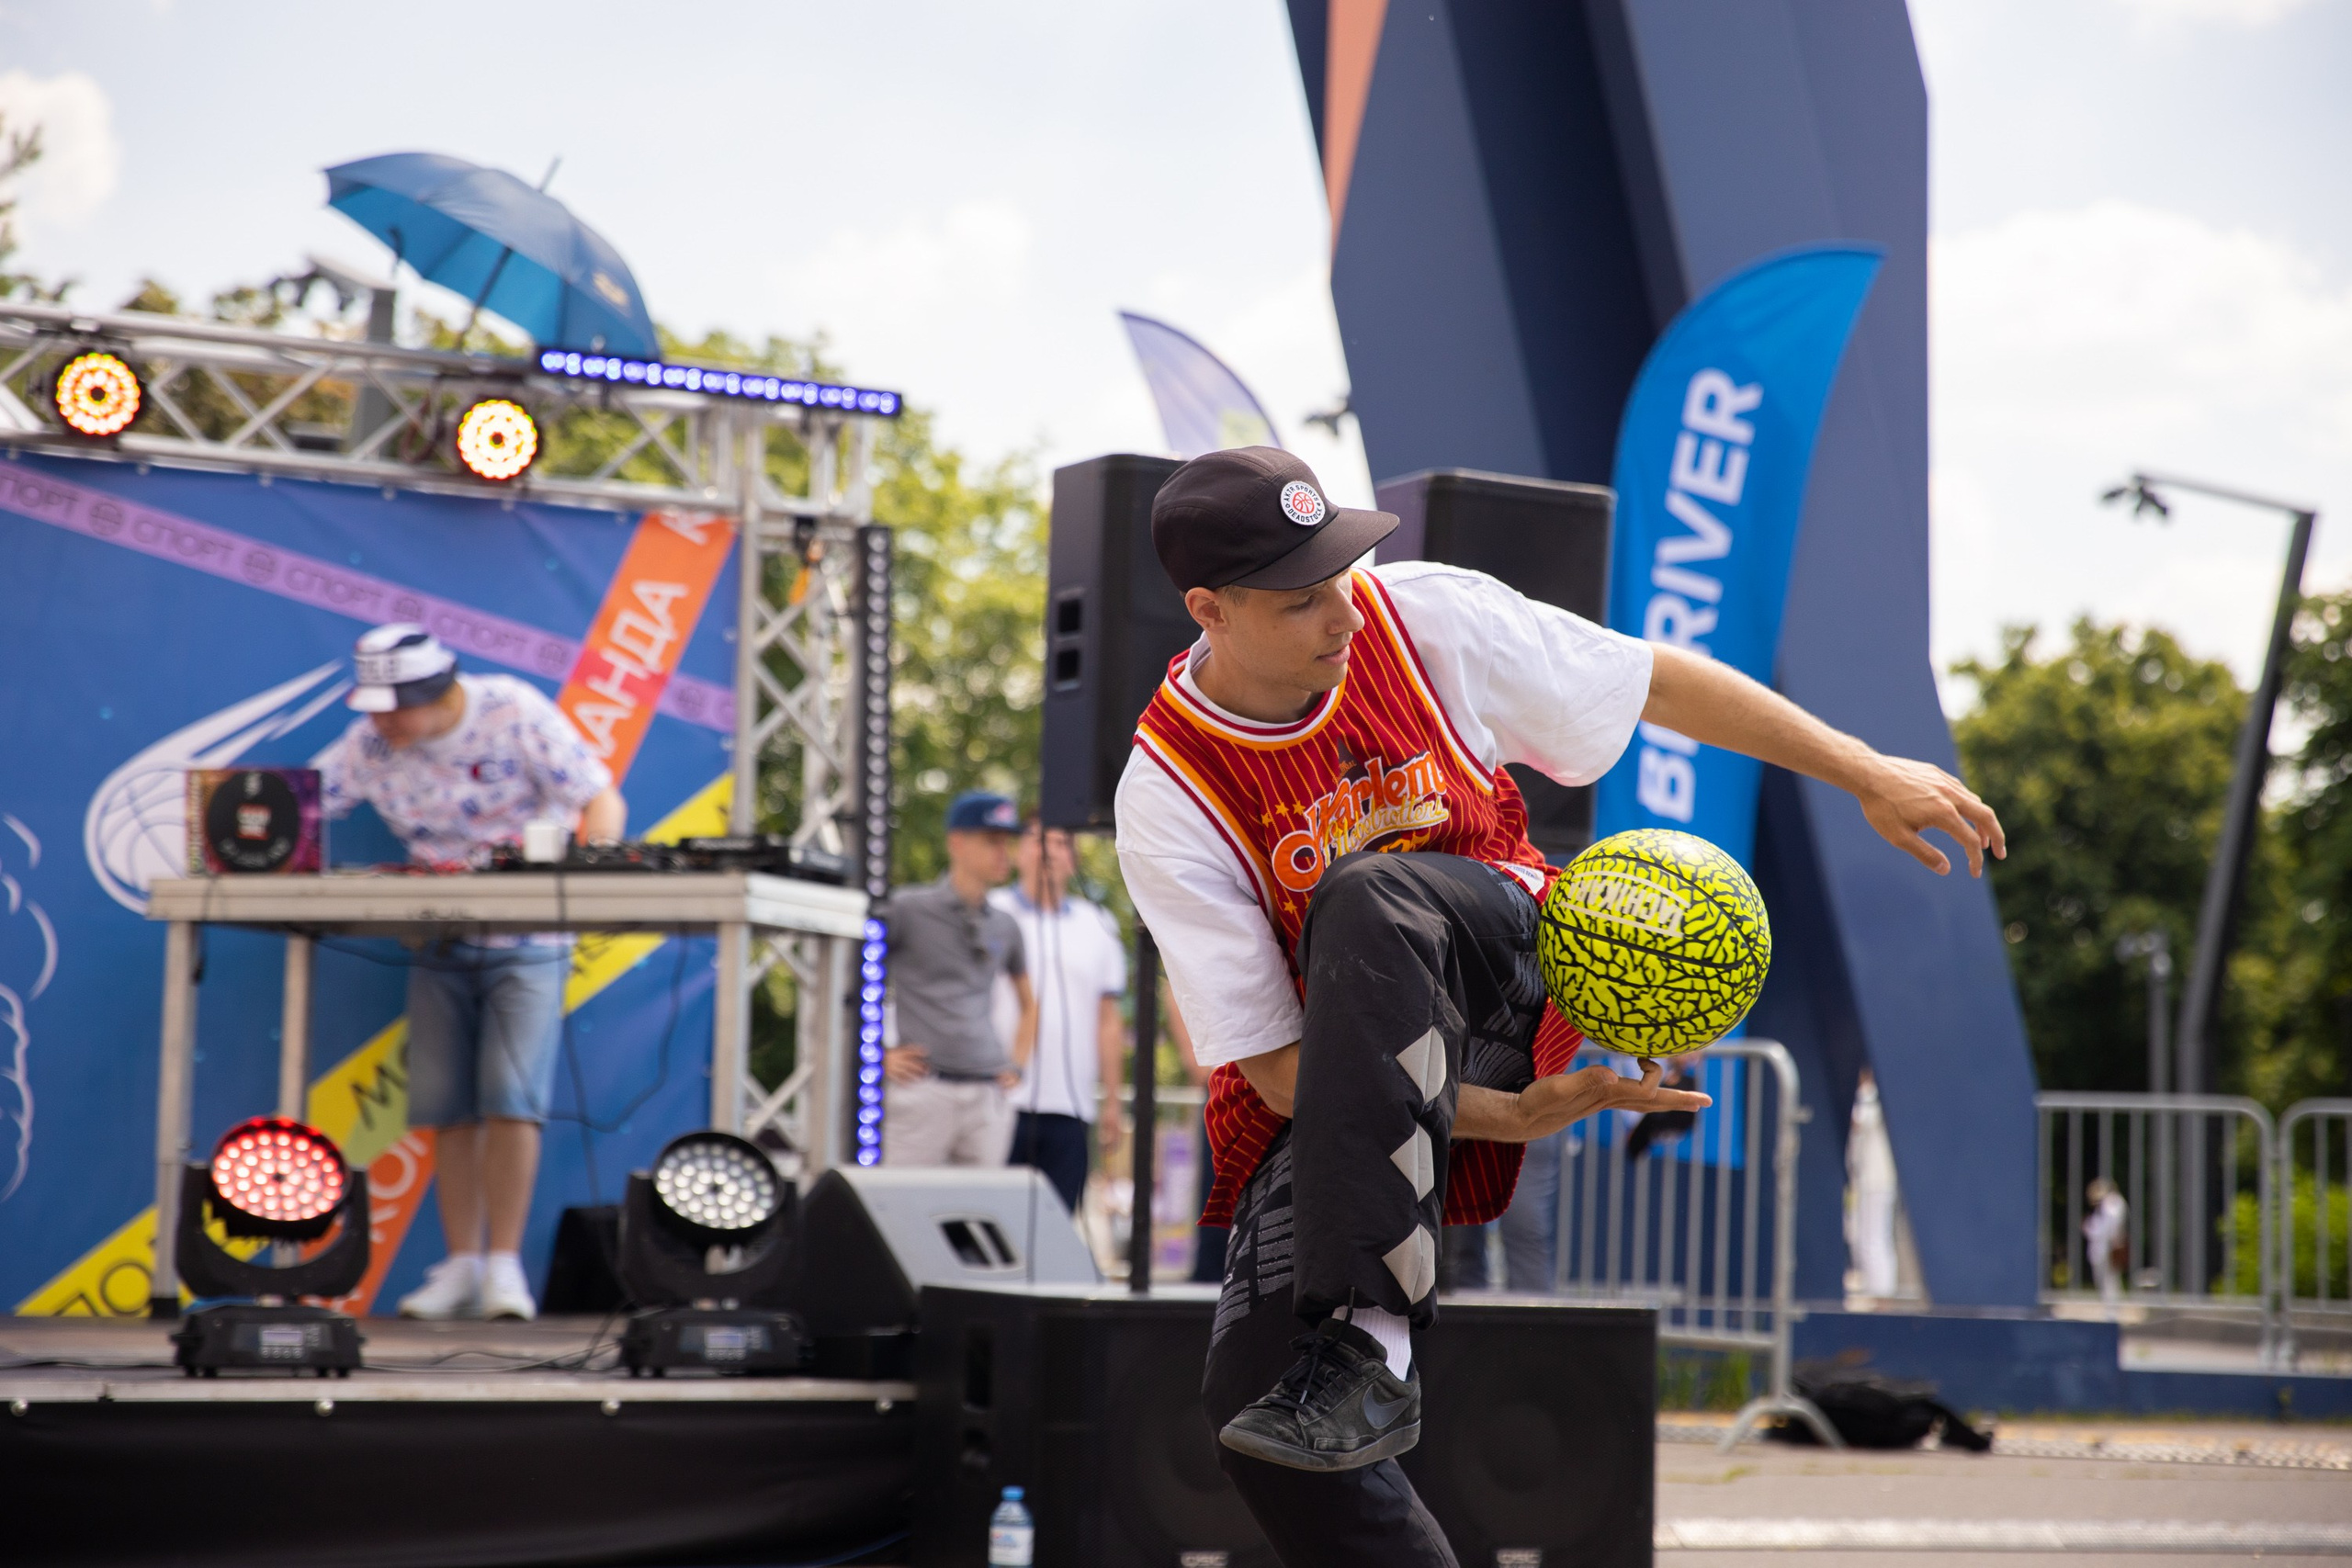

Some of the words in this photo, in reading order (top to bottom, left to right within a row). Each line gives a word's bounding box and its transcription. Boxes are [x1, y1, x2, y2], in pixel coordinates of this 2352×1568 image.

[1283, 486, 1296, 502] AKTR
[1295, 484, 1319, 502] SPORTS
[1287, 508, 1323, 523] DEADSTOCK
[131, 514, 236, 566] СПОРТ
[284, 561, 386, 611] СПОРТ
[573, 578, 691, 761] АНДА
[1272, 750, 1448, 893] Harlem
